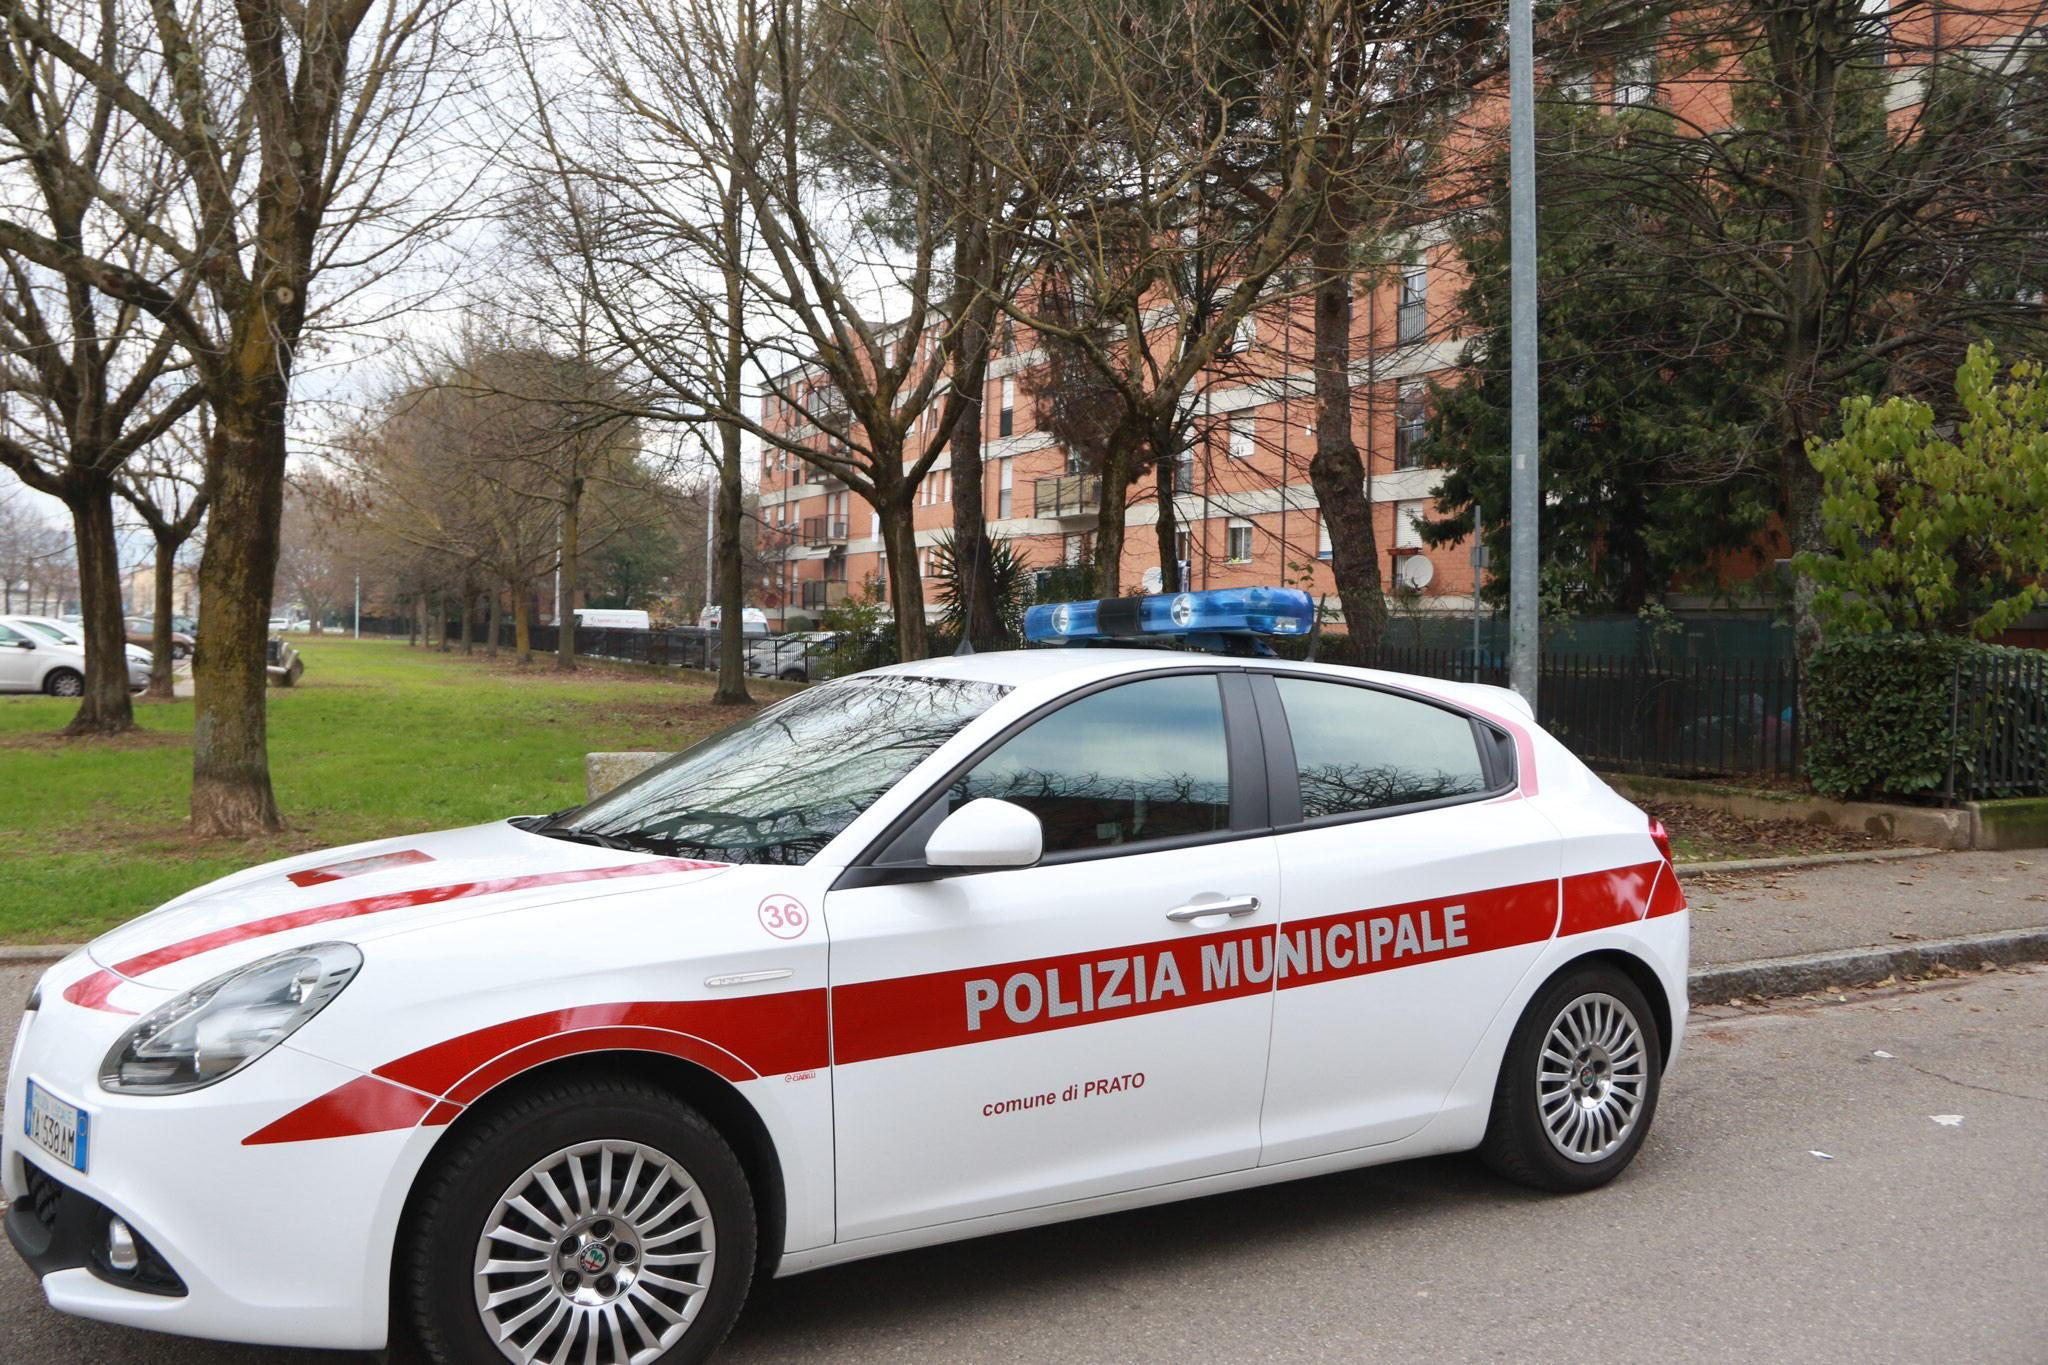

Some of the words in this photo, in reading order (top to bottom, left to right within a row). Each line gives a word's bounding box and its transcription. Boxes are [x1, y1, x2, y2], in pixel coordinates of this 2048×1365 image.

[764, 903, 803, 928] 36
[964, 951, 1186, 1031] POLIZIA
[1201, 905, 1469, 992] MUNICIPALE
[982, 1092, 1056, 1116] comune
[1062, 1084, 1078, 1101] di
[1084, 1072, 1145, 1098] PRATO
